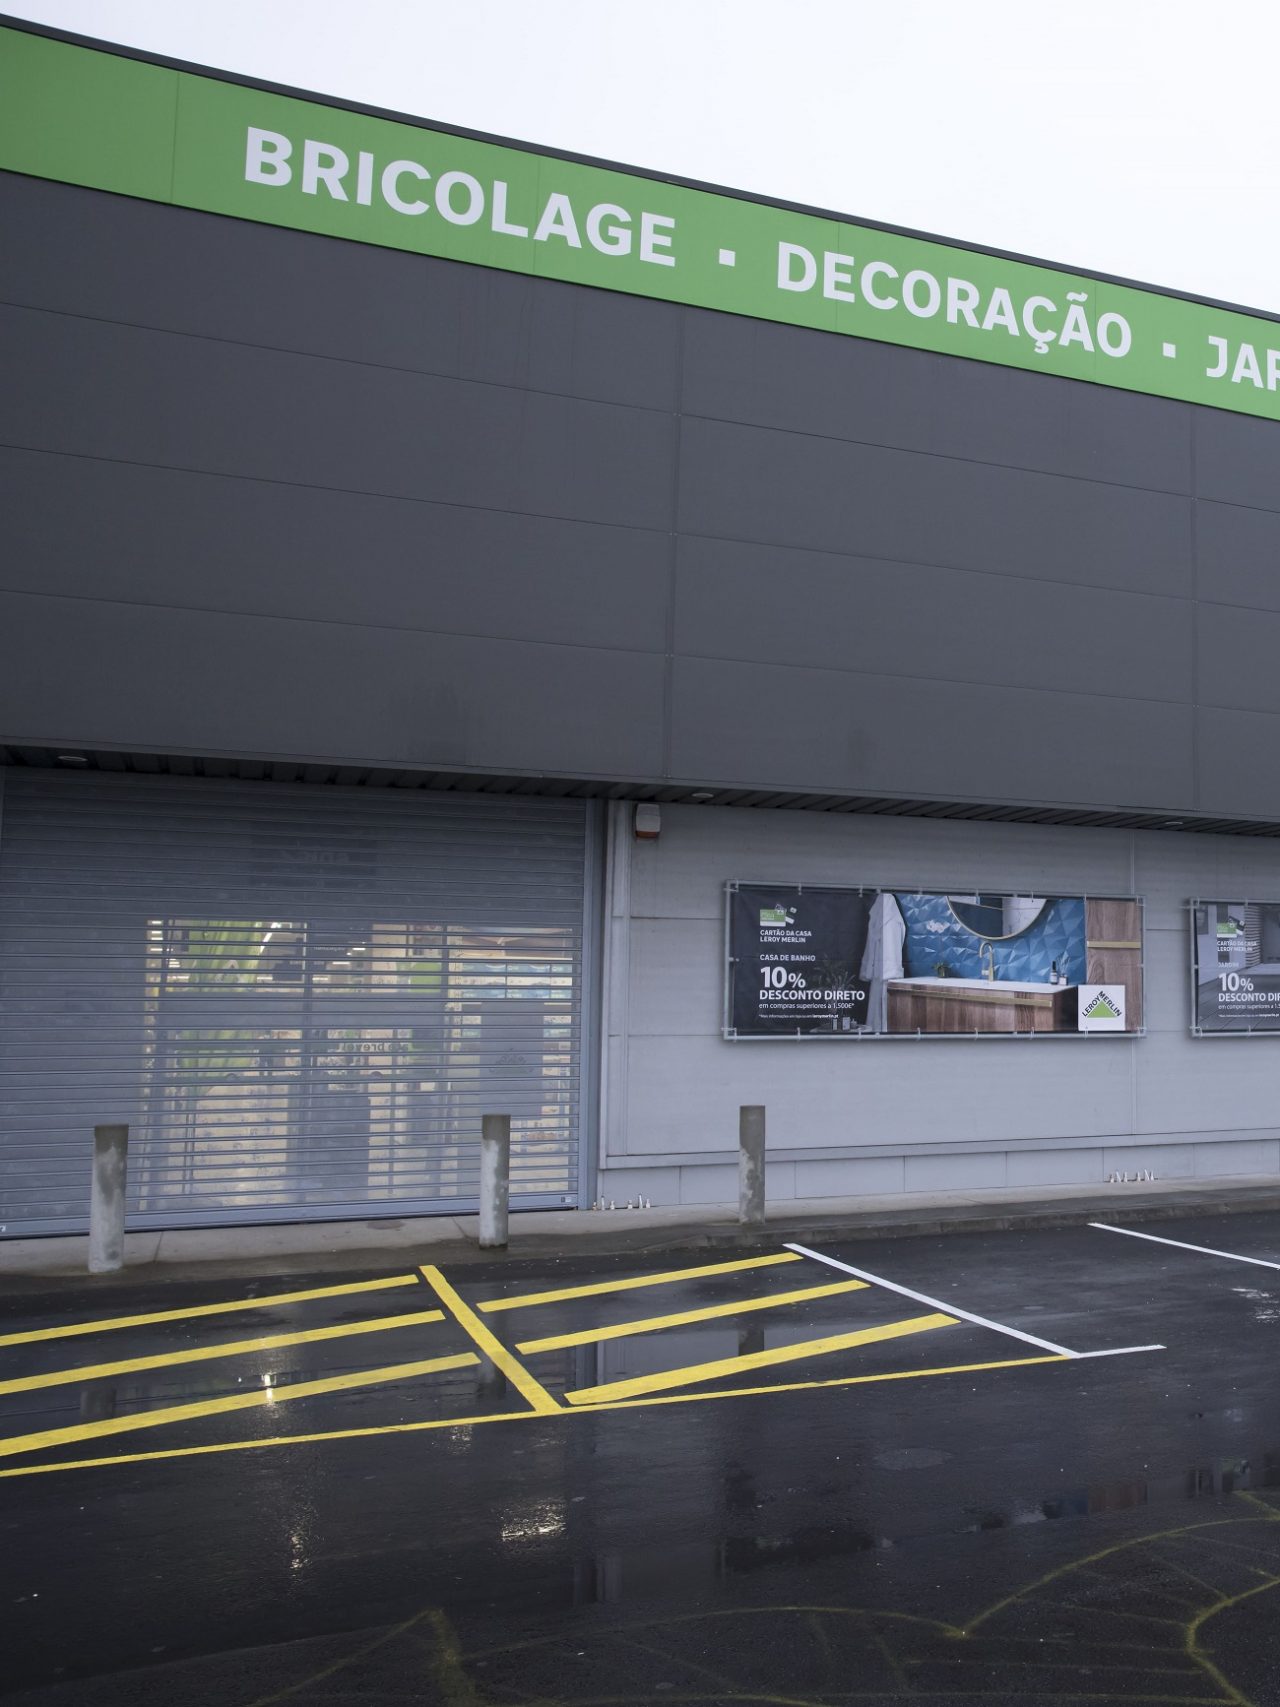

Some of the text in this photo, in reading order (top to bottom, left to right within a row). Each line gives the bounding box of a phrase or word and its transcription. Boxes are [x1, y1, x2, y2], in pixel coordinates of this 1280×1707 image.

[245, 126, 676, 268] BRICOLAGE
[777, 241, 1133, 357] DECORAÇÃO
[790, 954, 816, 962] BANHO
[760, 966, 807, 988] 10%
[1218, 972, 1254, 992] 10%
[759, 989, 866, 1001] DESCONTO DIRETO
[1218, 992, 1266, 1002] DESCONTO
[796, 1002, 827, 1010] superiores
[1081, 990, 1122, 1017] LEROY MERLIN
